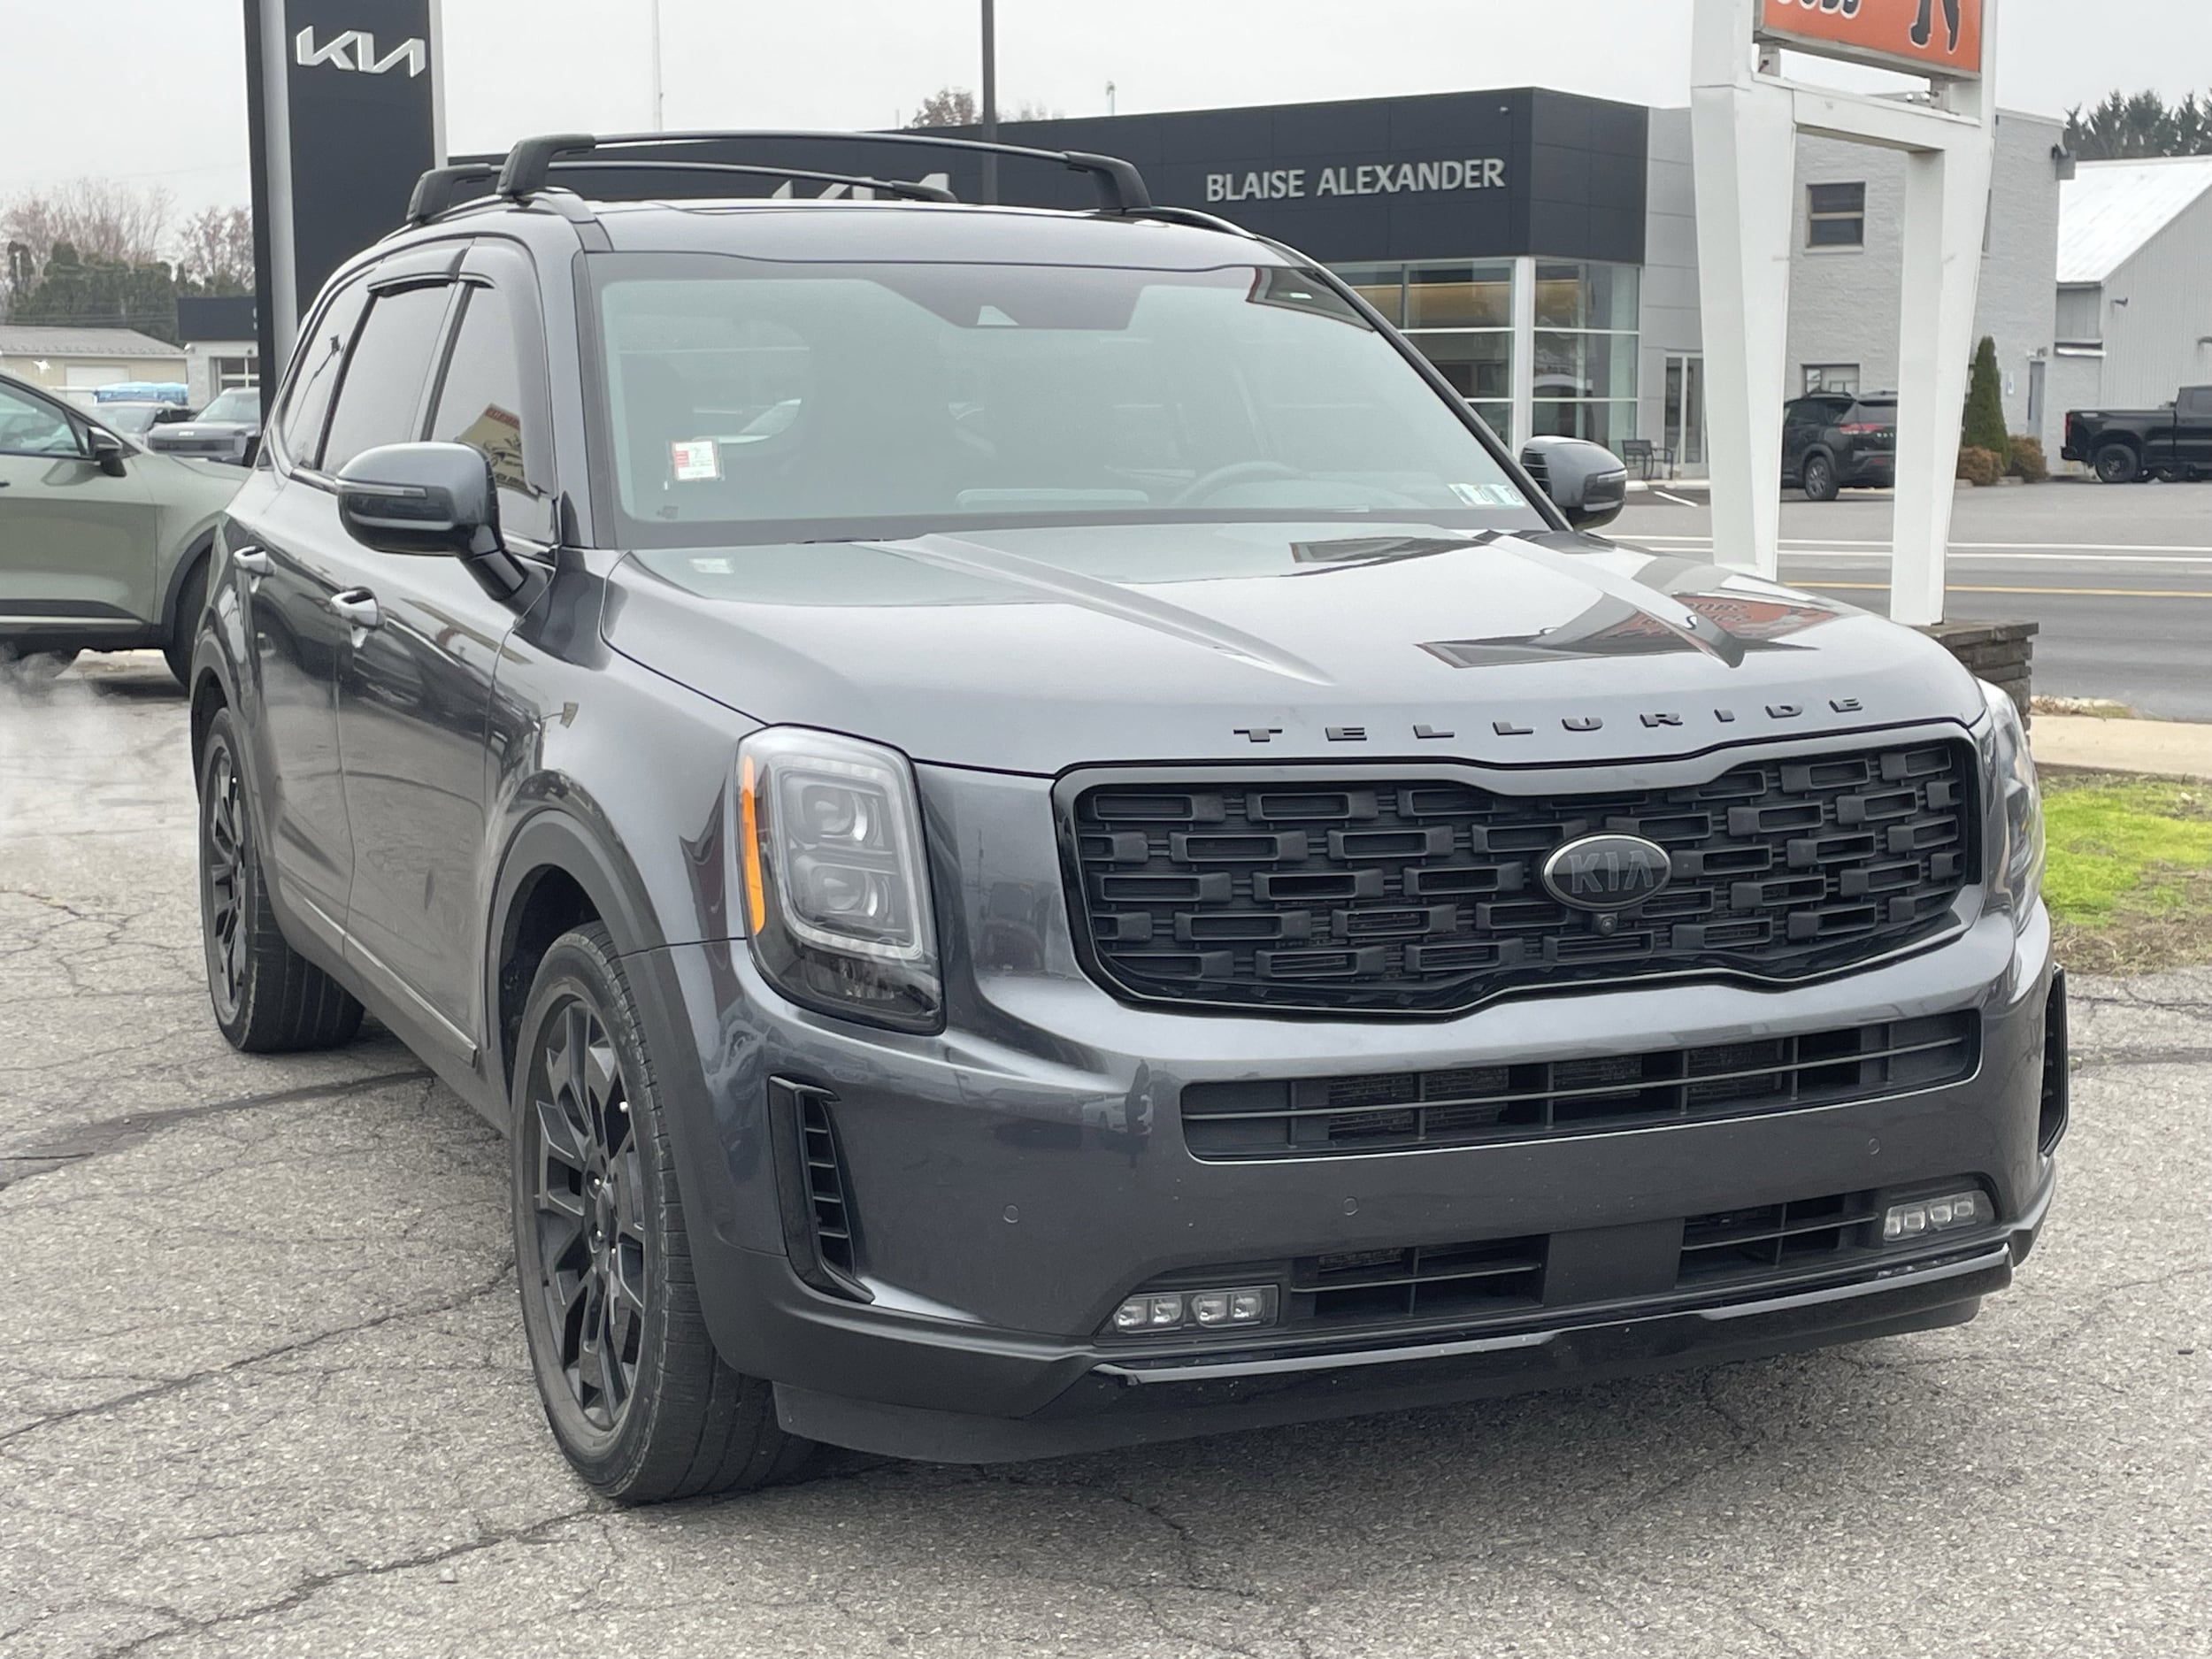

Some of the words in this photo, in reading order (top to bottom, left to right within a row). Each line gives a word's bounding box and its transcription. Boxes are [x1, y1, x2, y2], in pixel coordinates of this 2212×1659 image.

[296, 25, 426, 78] KIA
[1206, 169, 1306, 203] BLAISE
[1316, 157, 1506, 196] ALEXANDER
[1233, 697, 1863, 743] TELLURIDE
[1568, 849, 1655, 894] KIA
